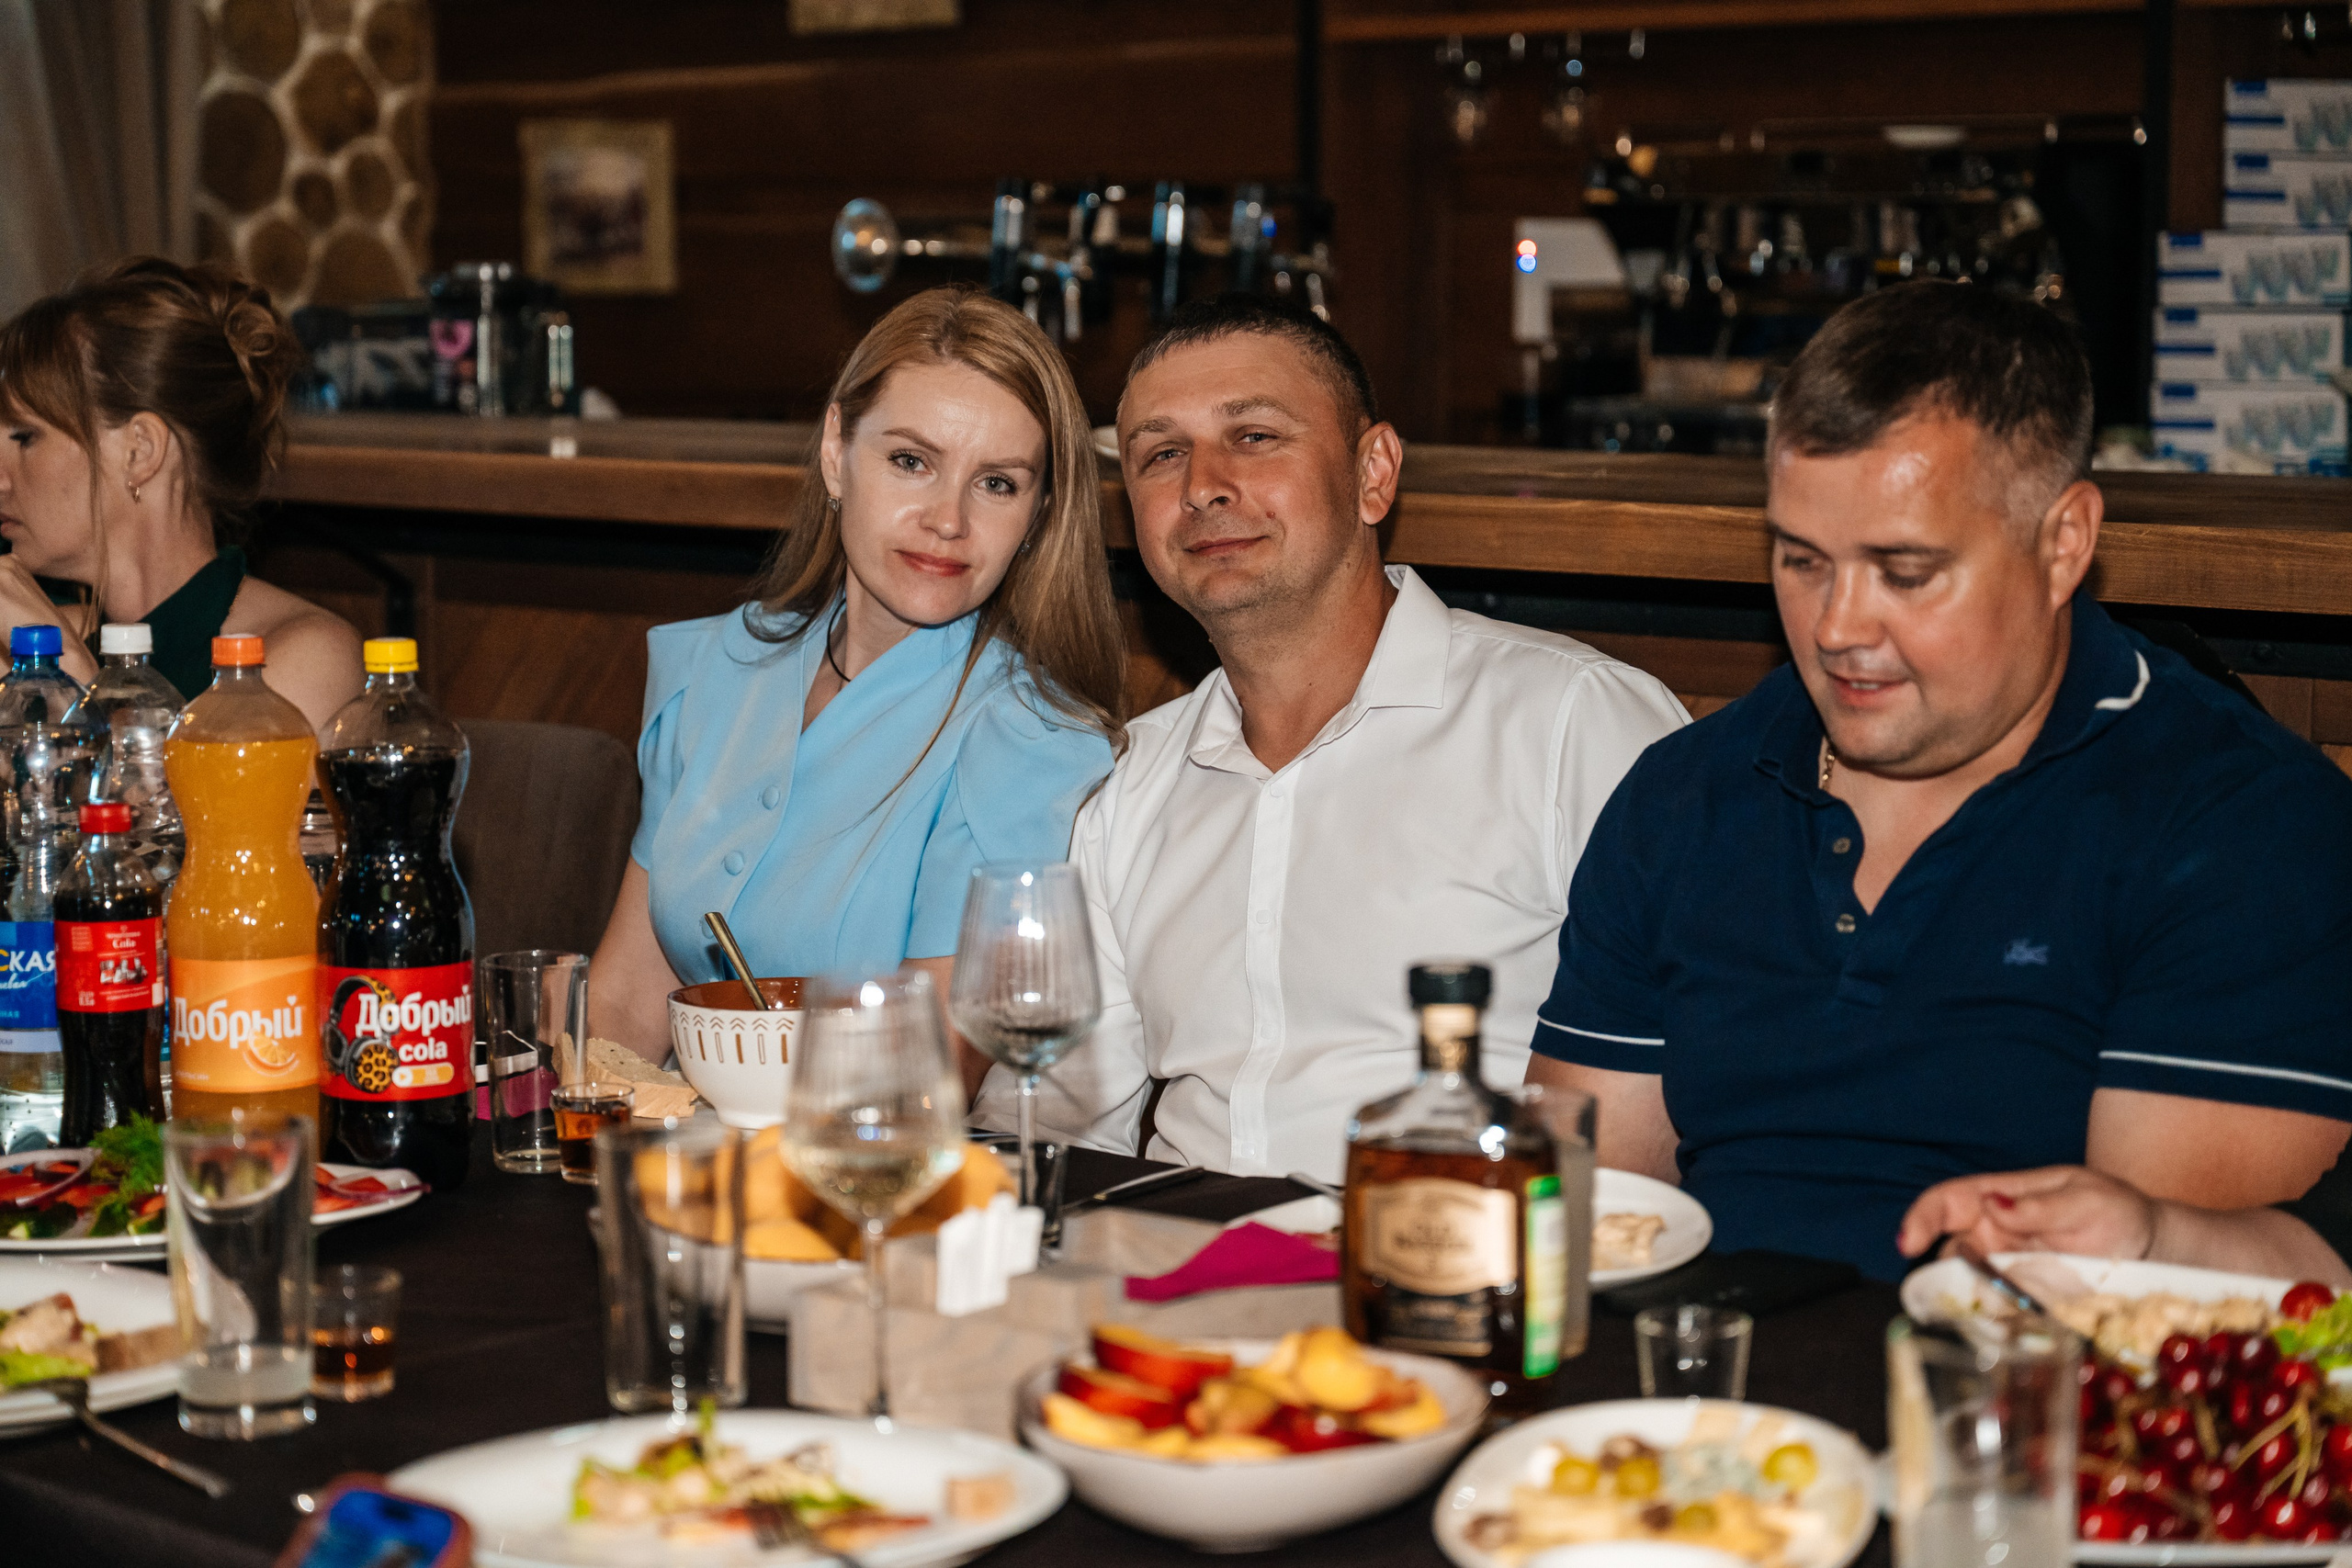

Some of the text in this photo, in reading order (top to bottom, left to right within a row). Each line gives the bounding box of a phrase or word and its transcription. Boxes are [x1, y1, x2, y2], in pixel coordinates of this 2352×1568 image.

[173, 995, 302, 1049] Добрый
[355, 984, 472, 1038] Добрый
[398, 1036, 448, 1063] cola
